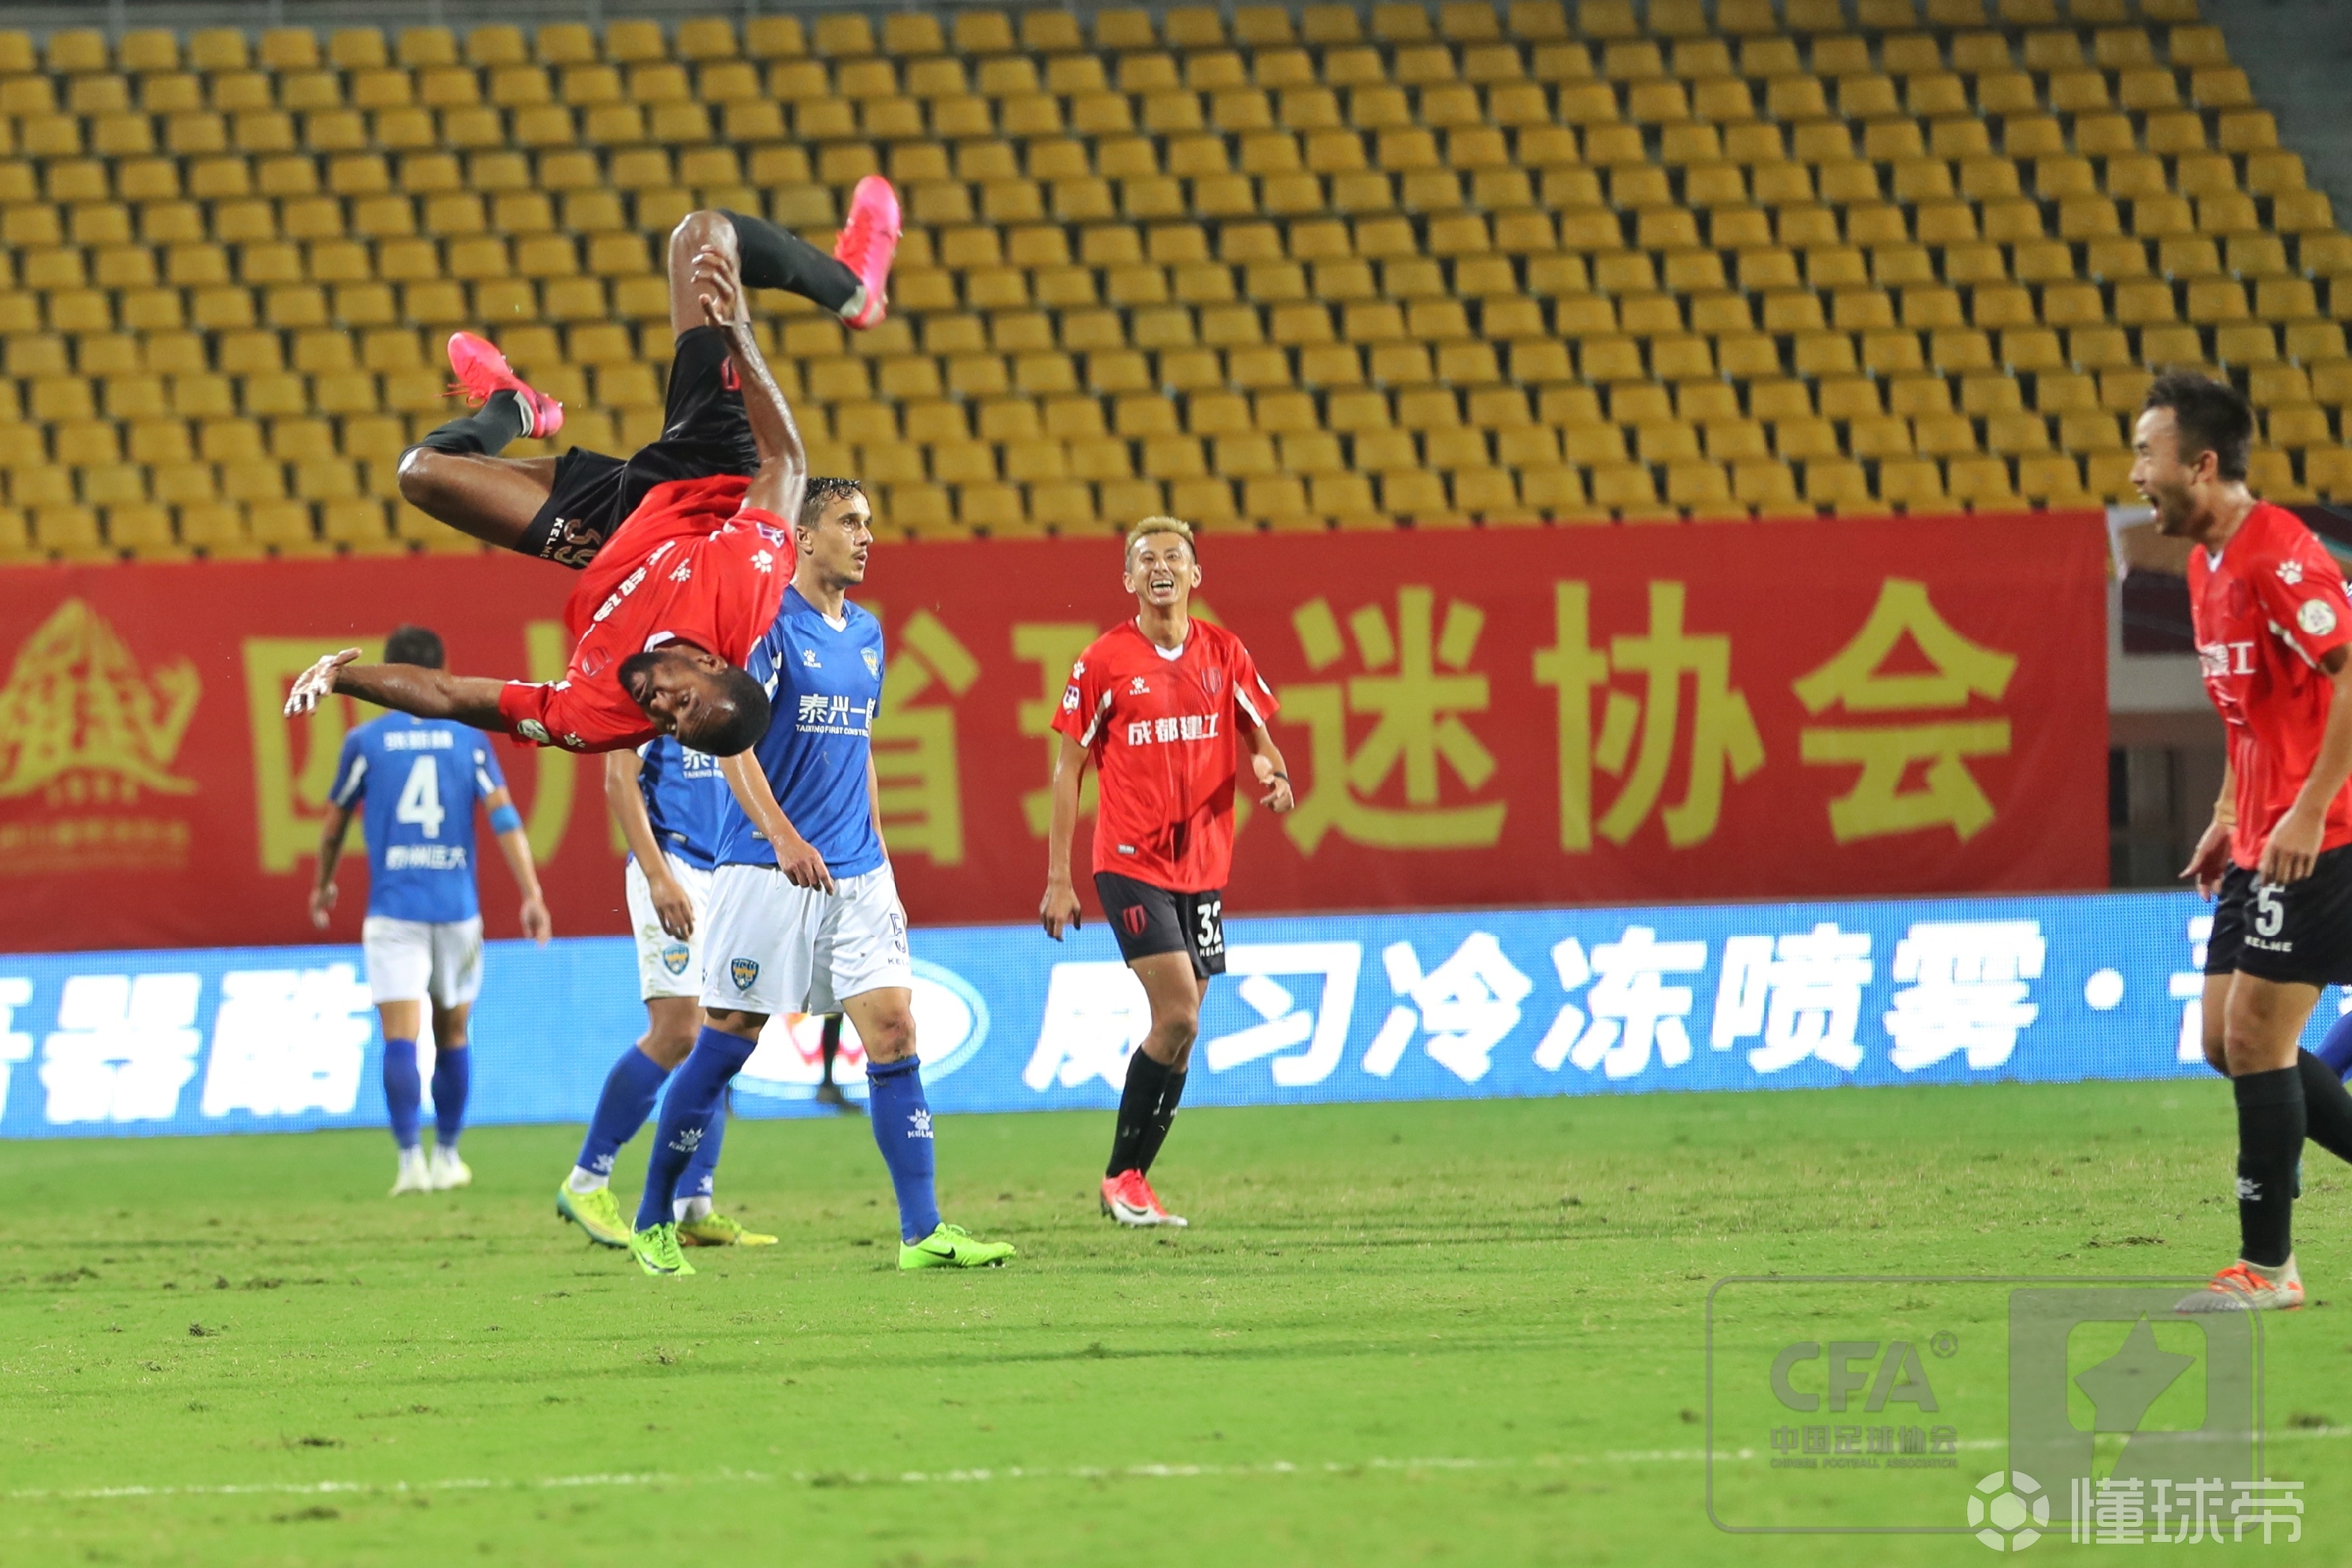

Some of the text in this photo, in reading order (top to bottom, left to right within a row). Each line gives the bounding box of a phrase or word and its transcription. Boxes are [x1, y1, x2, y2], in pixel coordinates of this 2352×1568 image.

[540, 517, 565, 559] KELME
[397, 754, 445, 839] 4
[1198, 900, 1221, 948] 32
[2255, 883, 2286, 937] 5
[2245, 935, 2293, 952] KELME
